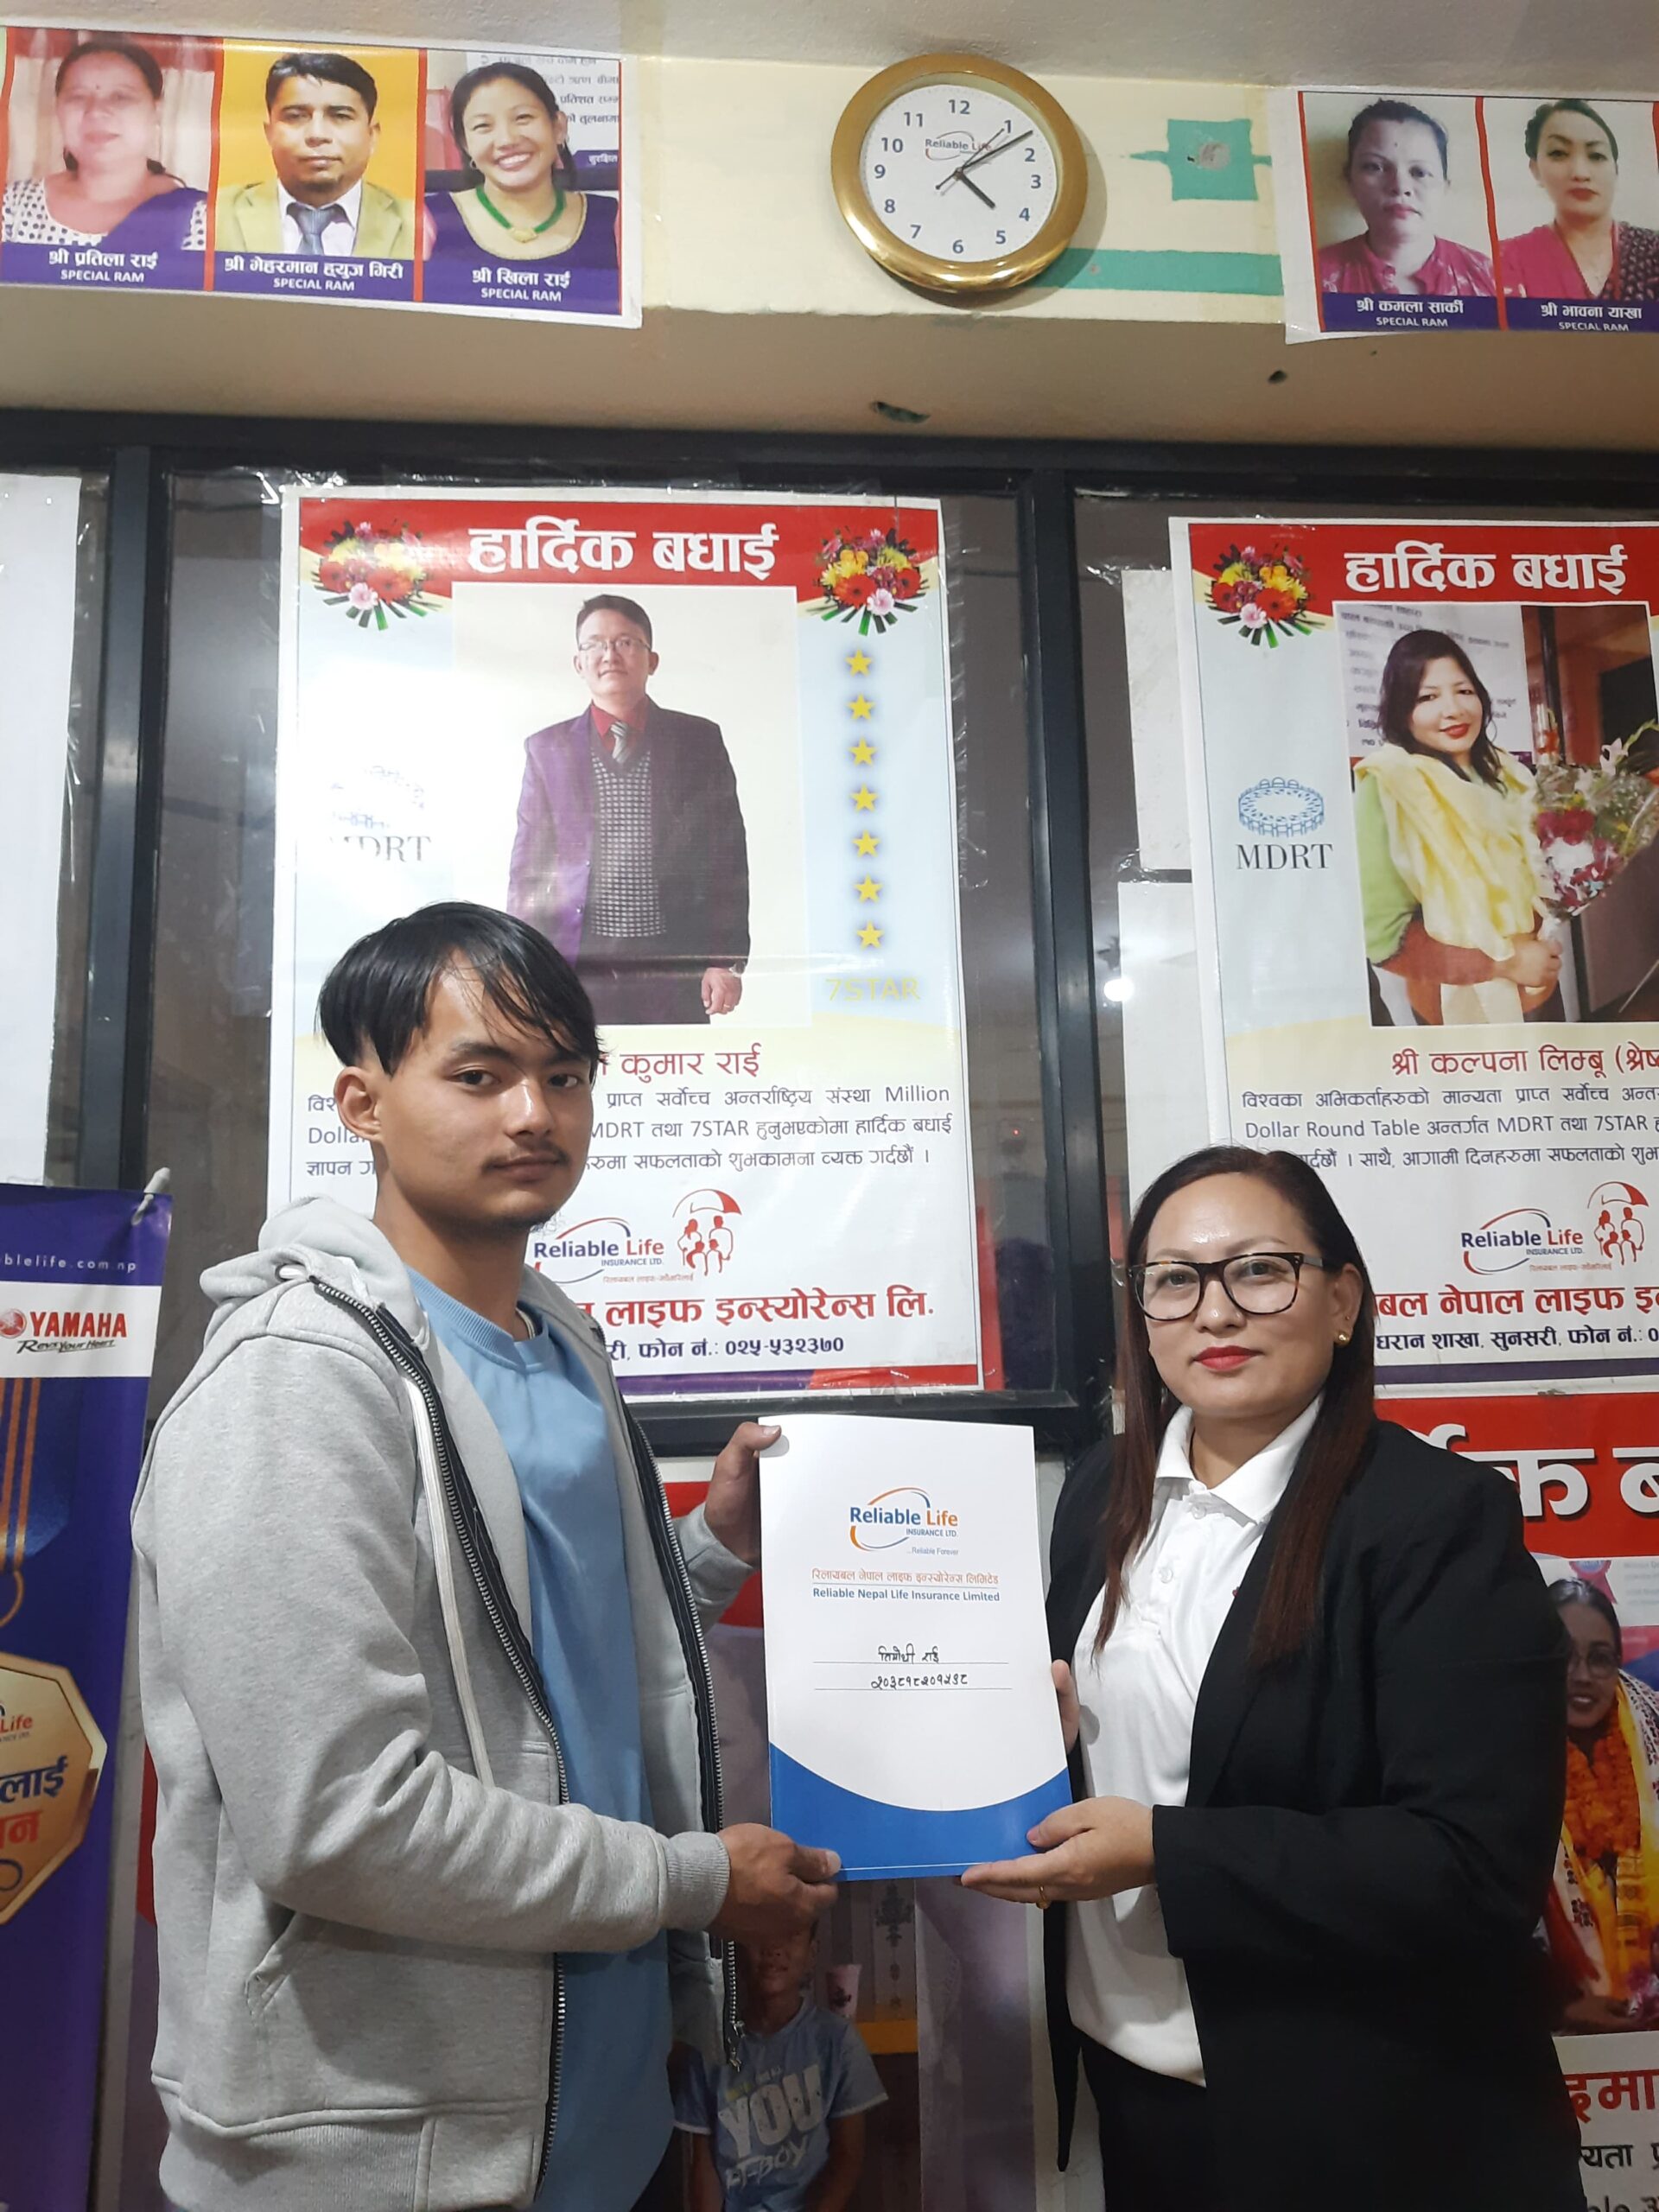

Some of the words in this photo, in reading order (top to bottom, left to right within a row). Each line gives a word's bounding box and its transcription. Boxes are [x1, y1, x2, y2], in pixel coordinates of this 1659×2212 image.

[948, 99, 970, 115] 12
[904, 112, 924, 127] 11
[1003, 120, 1012, 133] 1
[881, 137, 904, 153] 10
[925, 139, 968, 149] Reliable
[1024, 148, 1036, 163] 2
[874, 164, 886, 179] 9
[1030, 175, 1041, 189] 3
[884, 199, 896, 213] 8
[1018, 207, 1030, 222] 4
[910, 225, 922, 238] 7
[995, 231, 1007, 245] 5
[952, 239, 964, 254] 6
[49, 248, 69, 264] श्री
[130, 251, 158, 270] राई
[225, 255, 244, 271] श्री
[60, 269, 110, 282] SPECIAL
[114, 271, 144, 283] RAM
[273, 277, 321, 289] SPECIAL
[325, 281, 355, 291] RAM
[473, 267, 492, 283] श्री
[543, 270, 570, 289] राई
[481, 287, 529, 301] SPECIAL
[532, 289, 562, 302] RAM
[1357, 300, 1374, 313] श्री
[1379, 301, 1423, 314] कमला
[1541, 304, 1557, 317] श्री
[1563, 305, 1602, 318] भावना
[1376, 317, 1419, 327] SPECIAL
[1421, 318, 1447, 327] RAM
[1559, 321, 1601, 331] SPECIAL
[1603, 323, 1629, 332] RAM
[467, 515, 637, 575] हार्दिक
[652, 523, 780, 581] बधाई
[1344, 539, 1497, 593] हार्दिक
[1511, 543, 1628, 595] बधाई
[1236, 843, 1333, 870] MDRT
[825, 977, 921, 1002] 7STAR
[620, 1052, 704, 1084] कुमार
[715, 1042, 762, 1078] राई
[1392, 1048, 1419, 1076] श्री
[1428, 1050, 1529, 1074] कल्पना
[1538, 1044, 1607, 1078] लिम्बू
[607, 1093, 643, 1109] प्राप्त
[656, 1086, 711, 1106] सर्वोच्च
[825, 1086, 871, 1103] संस्था
[886, 1084, 950, 1103] Million
[1243, 1091, 1303, 1108] विश्वका
[1315, 1086, 1430, 1108] अभिकर्ताहरुको
[1442, 1090, 1503, 1104] मान्यता
[1516, 1088, 1550, 1103] प्राप्त
[1560, 1083, 1609, 1102] सर्वोच्च
[651, 1122, 683, 1137] तथा
[691, 1120, 749, 1137] 7STAR
[756, 1116, 849, 1141] हुनुभएकोमा
[855, 1114, 906, 1135] हार्दिक
[912, 1113, 953, 1135] बधाई
[1245, 1121, 1300, 1139] Dollar
[1306, 1120, 1365, 1137] Round
[1370, 1119, 1420, 1136] Table
[1427, 1115, 1490, 1135] अन्तर्गत
[1497, 1116, 1554, 1134] MDRT
[1560, 1117, 1587, 1131] तथा
[1594, 1115, 1649, 1131] 7STAR
[306, 1160, 353, 1176] ज्ञापन
[633, 1148, 722, 1169] सफलताको
[728, 1152, 815, 1173] शुभकामना
[821, 1150, 863, 1165] व्यक्त
[1402, 1147, 1459, 1166] आगामी
[1465, 1147, 1541, 1166] दिनहरुमा
[1546, 1142, 1625, 1161] सफलताको
[1460, 1230, 1541, 1248] Reliable
[1548, 1229, 1583, 1245] Life
[534, 1240, 620, 1258] Reliable
[626, 1239, 664, 1255] Life
[601, 1258, 647, 1267] INSURANCE
[605, 1299, 705, 1329] लाइफ
[715, 1287, 876, 1326] इन्स्योरेन्स
[887, 1284, 934, 1318] लि.
[1438, 1284, 1524, 1315] नेपाल
[1534, 1287, 1625, 1316] लाइफ
[29, 1311, 127, 1338] YAMAHA
[1567, 1325, 1611, 1344] फोन
[638, 1338, 684, 1358] फोन
[725, 1337, 844, 1357] ०२५-५३२३७०
[849, 1506, 921, 1525] Reliable
[926, 1510, 958, 1527] Life
[906, 1528, 944, 1537] INSURANCE
[937, 1548, 959, 1556] Forever
[811, 1567, 855, 1580] रिलायबल
[859, 1567, 883, 1581] नेपाल
[887, 1571, 912, 1583] लाइफ
[915, 1571, 963, 1583] इन्स्योरेन्स
[966, 1572, 999, 1585] लिमिटेड
[813, 1588, 855, 1598] Reliable
[858, 1590, 887, 1600] Nepal
[891, 1590, 909, 1599] Life
[912, 1590, 960, 1600] Insurance
[963, 1592, 1000, 1601] Limited
[718, 2063, 822, 2158] YOU
